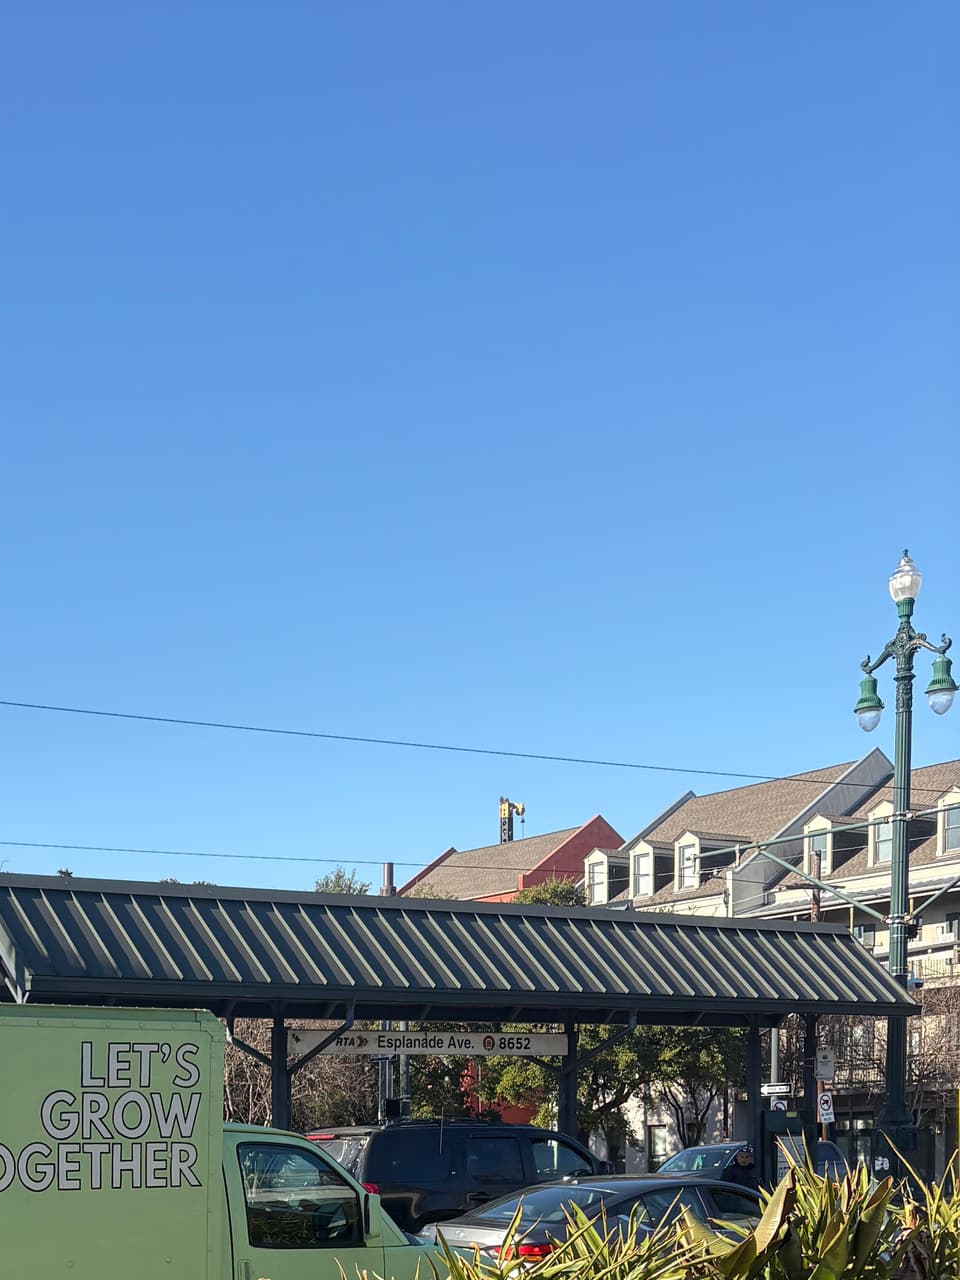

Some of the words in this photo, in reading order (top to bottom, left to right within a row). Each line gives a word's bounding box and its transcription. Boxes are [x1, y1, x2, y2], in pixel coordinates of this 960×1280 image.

[80, 1041, 200, 1088] LET'S
[377, 1034, 444, 1051] Esplanade
[447, 1036, 475, 1049] Ave.
[499, 1037, 531, 1049] 8652
[40, 1090, 202, 1140] GROW
